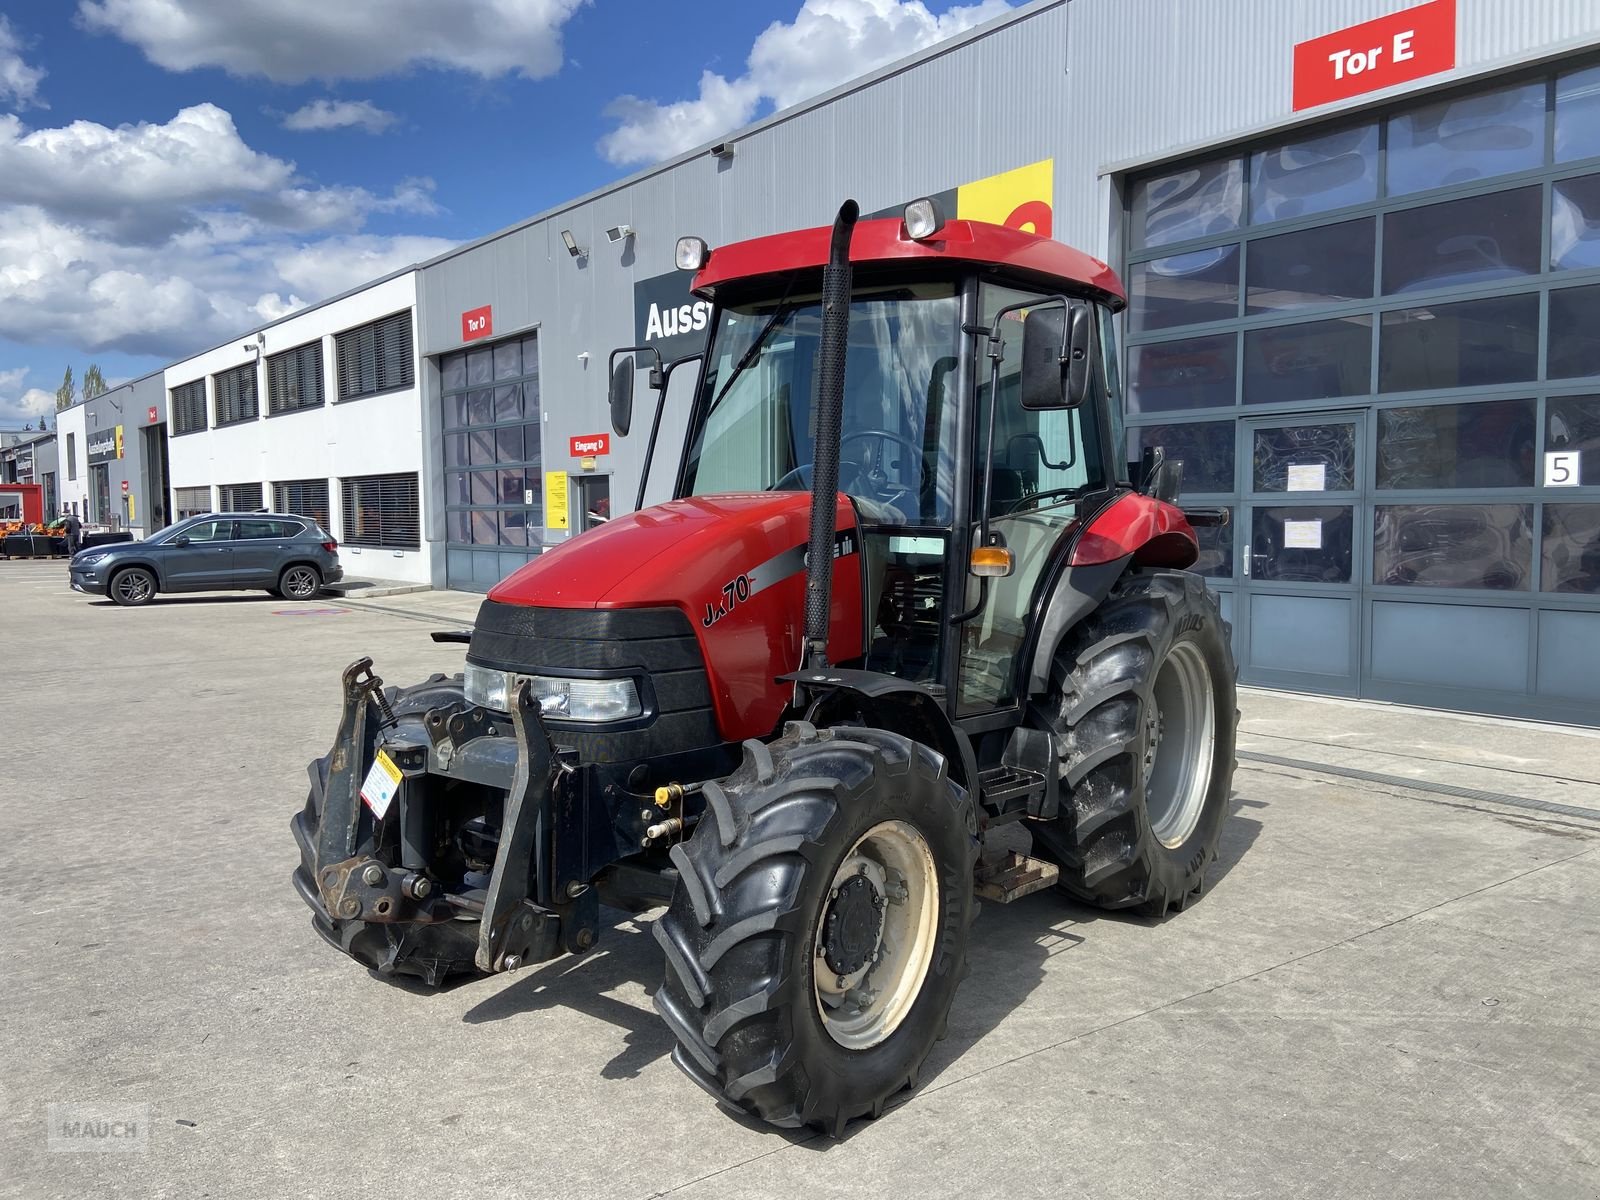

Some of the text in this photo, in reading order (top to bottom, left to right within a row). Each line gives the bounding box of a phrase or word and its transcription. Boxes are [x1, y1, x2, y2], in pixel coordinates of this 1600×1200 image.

[1328, 30, 1414, 80] Tor E
[468, 316, 486, 332] Tor D
[575, 439, 604, 453] Eingang D
[1551, 456, 1570, 483] 5
